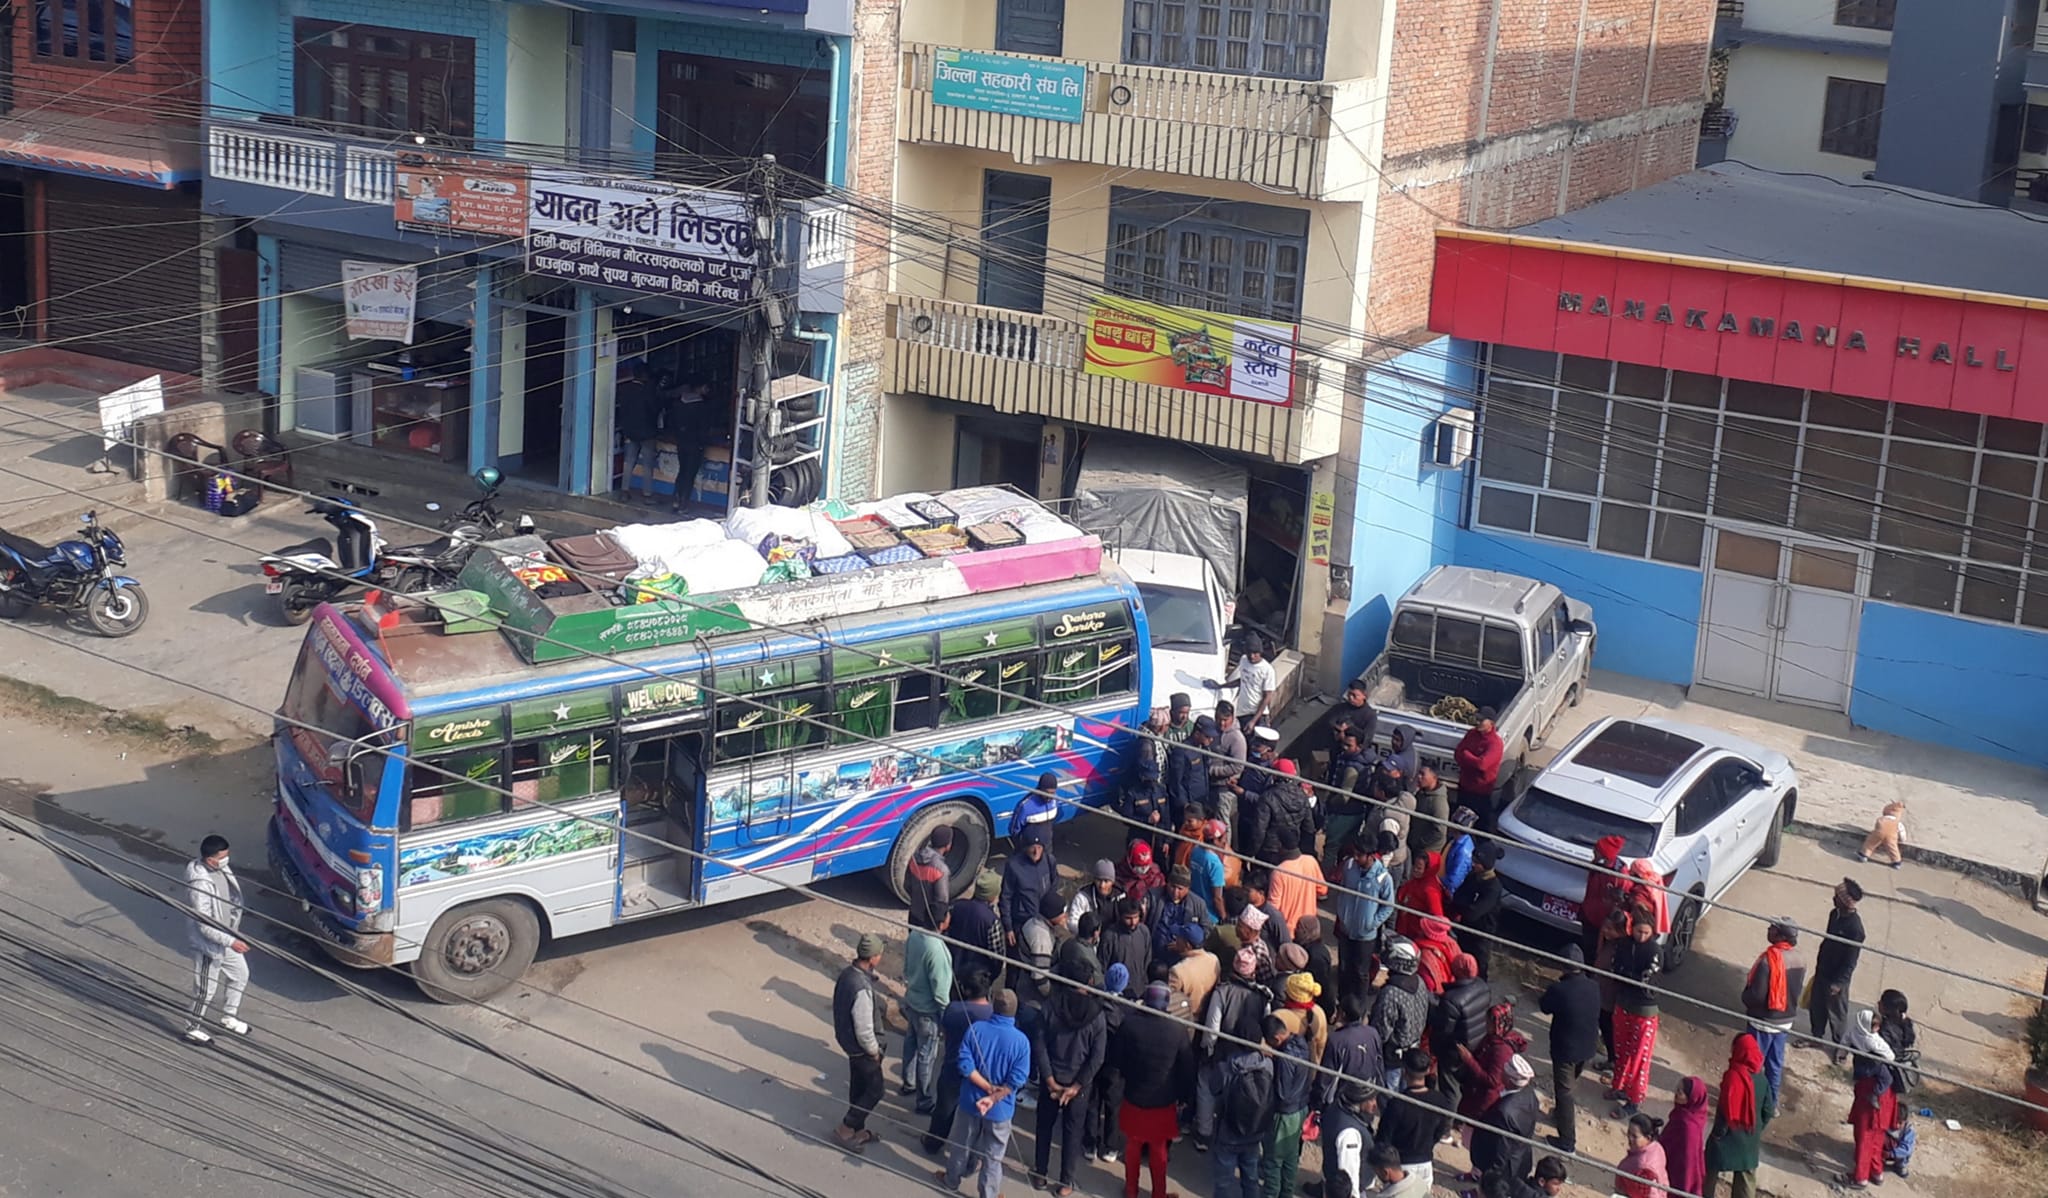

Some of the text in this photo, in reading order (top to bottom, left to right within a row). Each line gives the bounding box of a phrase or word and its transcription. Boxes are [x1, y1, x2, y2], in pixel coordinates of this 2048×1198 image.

[936, 61, 977, 84] जिल्ला
[981, 71, 1033, 92] सहकारी
[1035, 76, 1057, 95] संघ
[535, 190, 601, 226] यादव
[609, 198, 661, 236] अटो
[533, 234, 556, 249] हामी
[584, 239, 621, 259] विभिन्न
[624, 247, 705, 274] मोटरसाइकलको
[602, 267, 628, 283] सुपथ
[702, 281, 739, 301] गरिन्छ
[1558, 290, 2015, 372] MANAKAMANA HALL
[430, 719, 490, 742] Amisha
